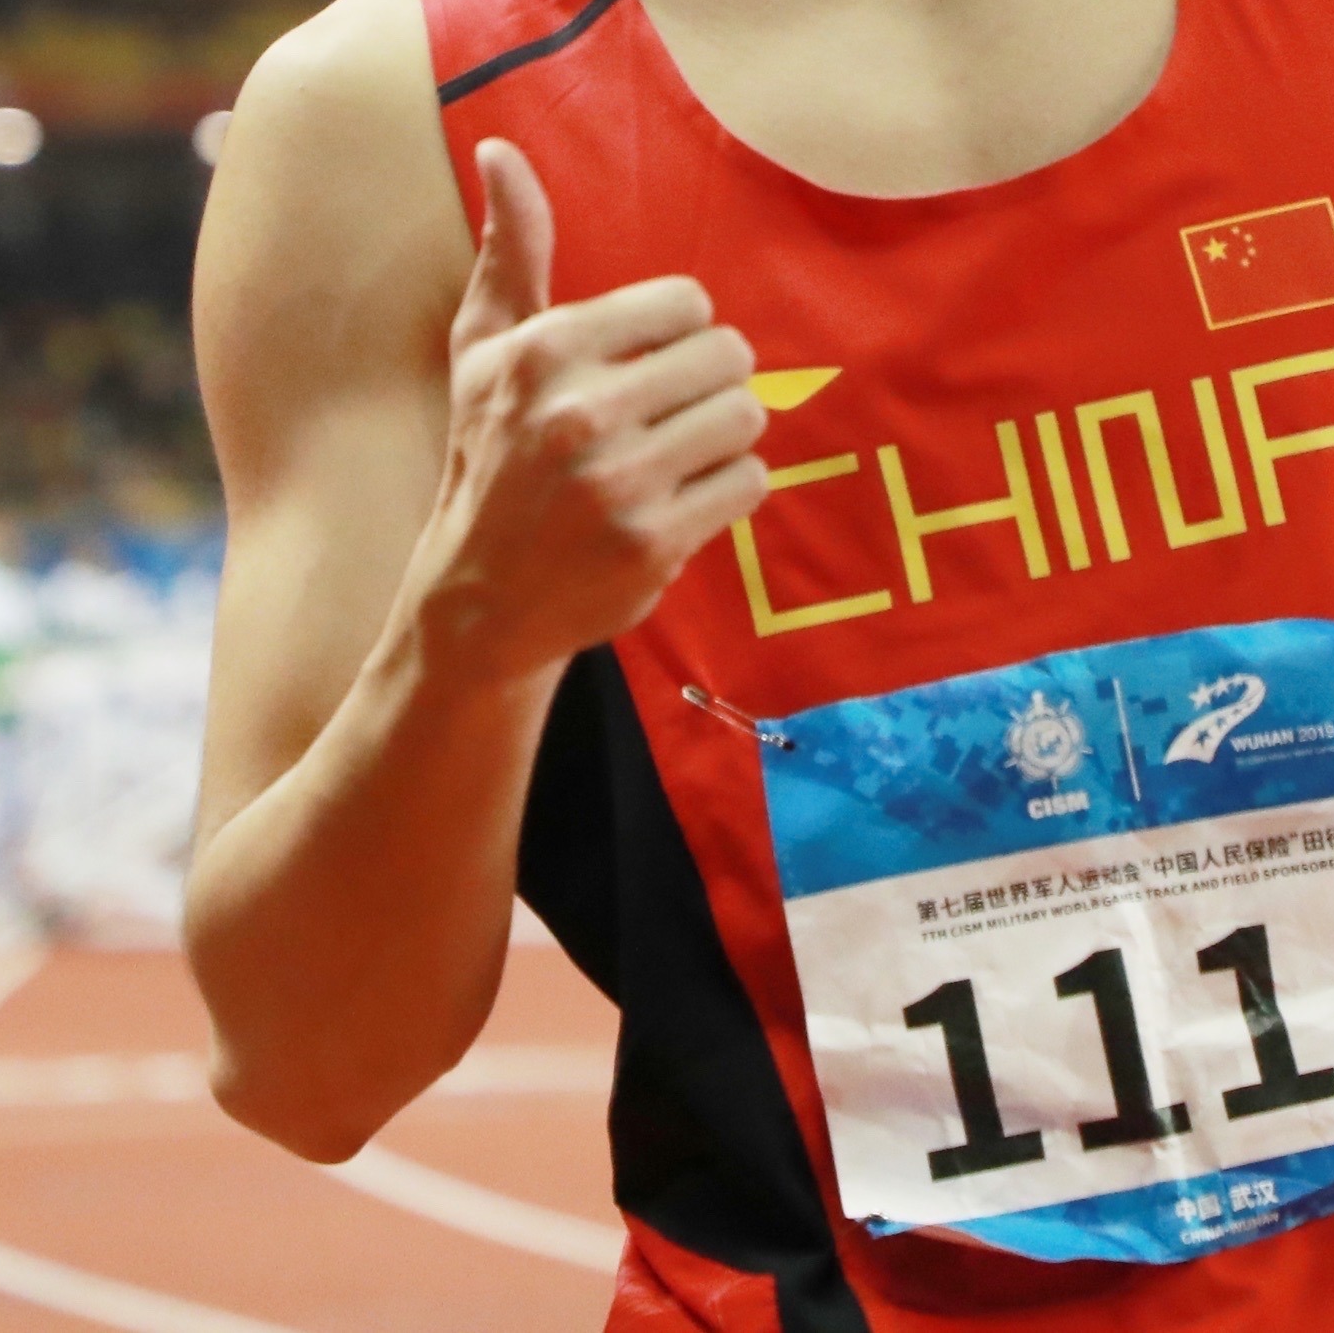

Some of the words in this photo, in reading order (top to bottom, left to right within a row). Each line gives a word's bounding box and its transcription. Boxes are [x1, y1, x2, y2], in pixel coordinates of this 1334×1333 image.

[1231, 730, 1293, 752] WUHAN
[1298, 722, 1334, 742] 2019
[1028, 791, 1089, 819] CISM
[986, 908, 1048, 931] MILITARY
[1050, 899, 1100, 917] WORLD
[1145, 883, 1189, 901] TRACK
[1191, 877, 1219, 892] AND
[1221, 870, 1260, 888] FIELD
